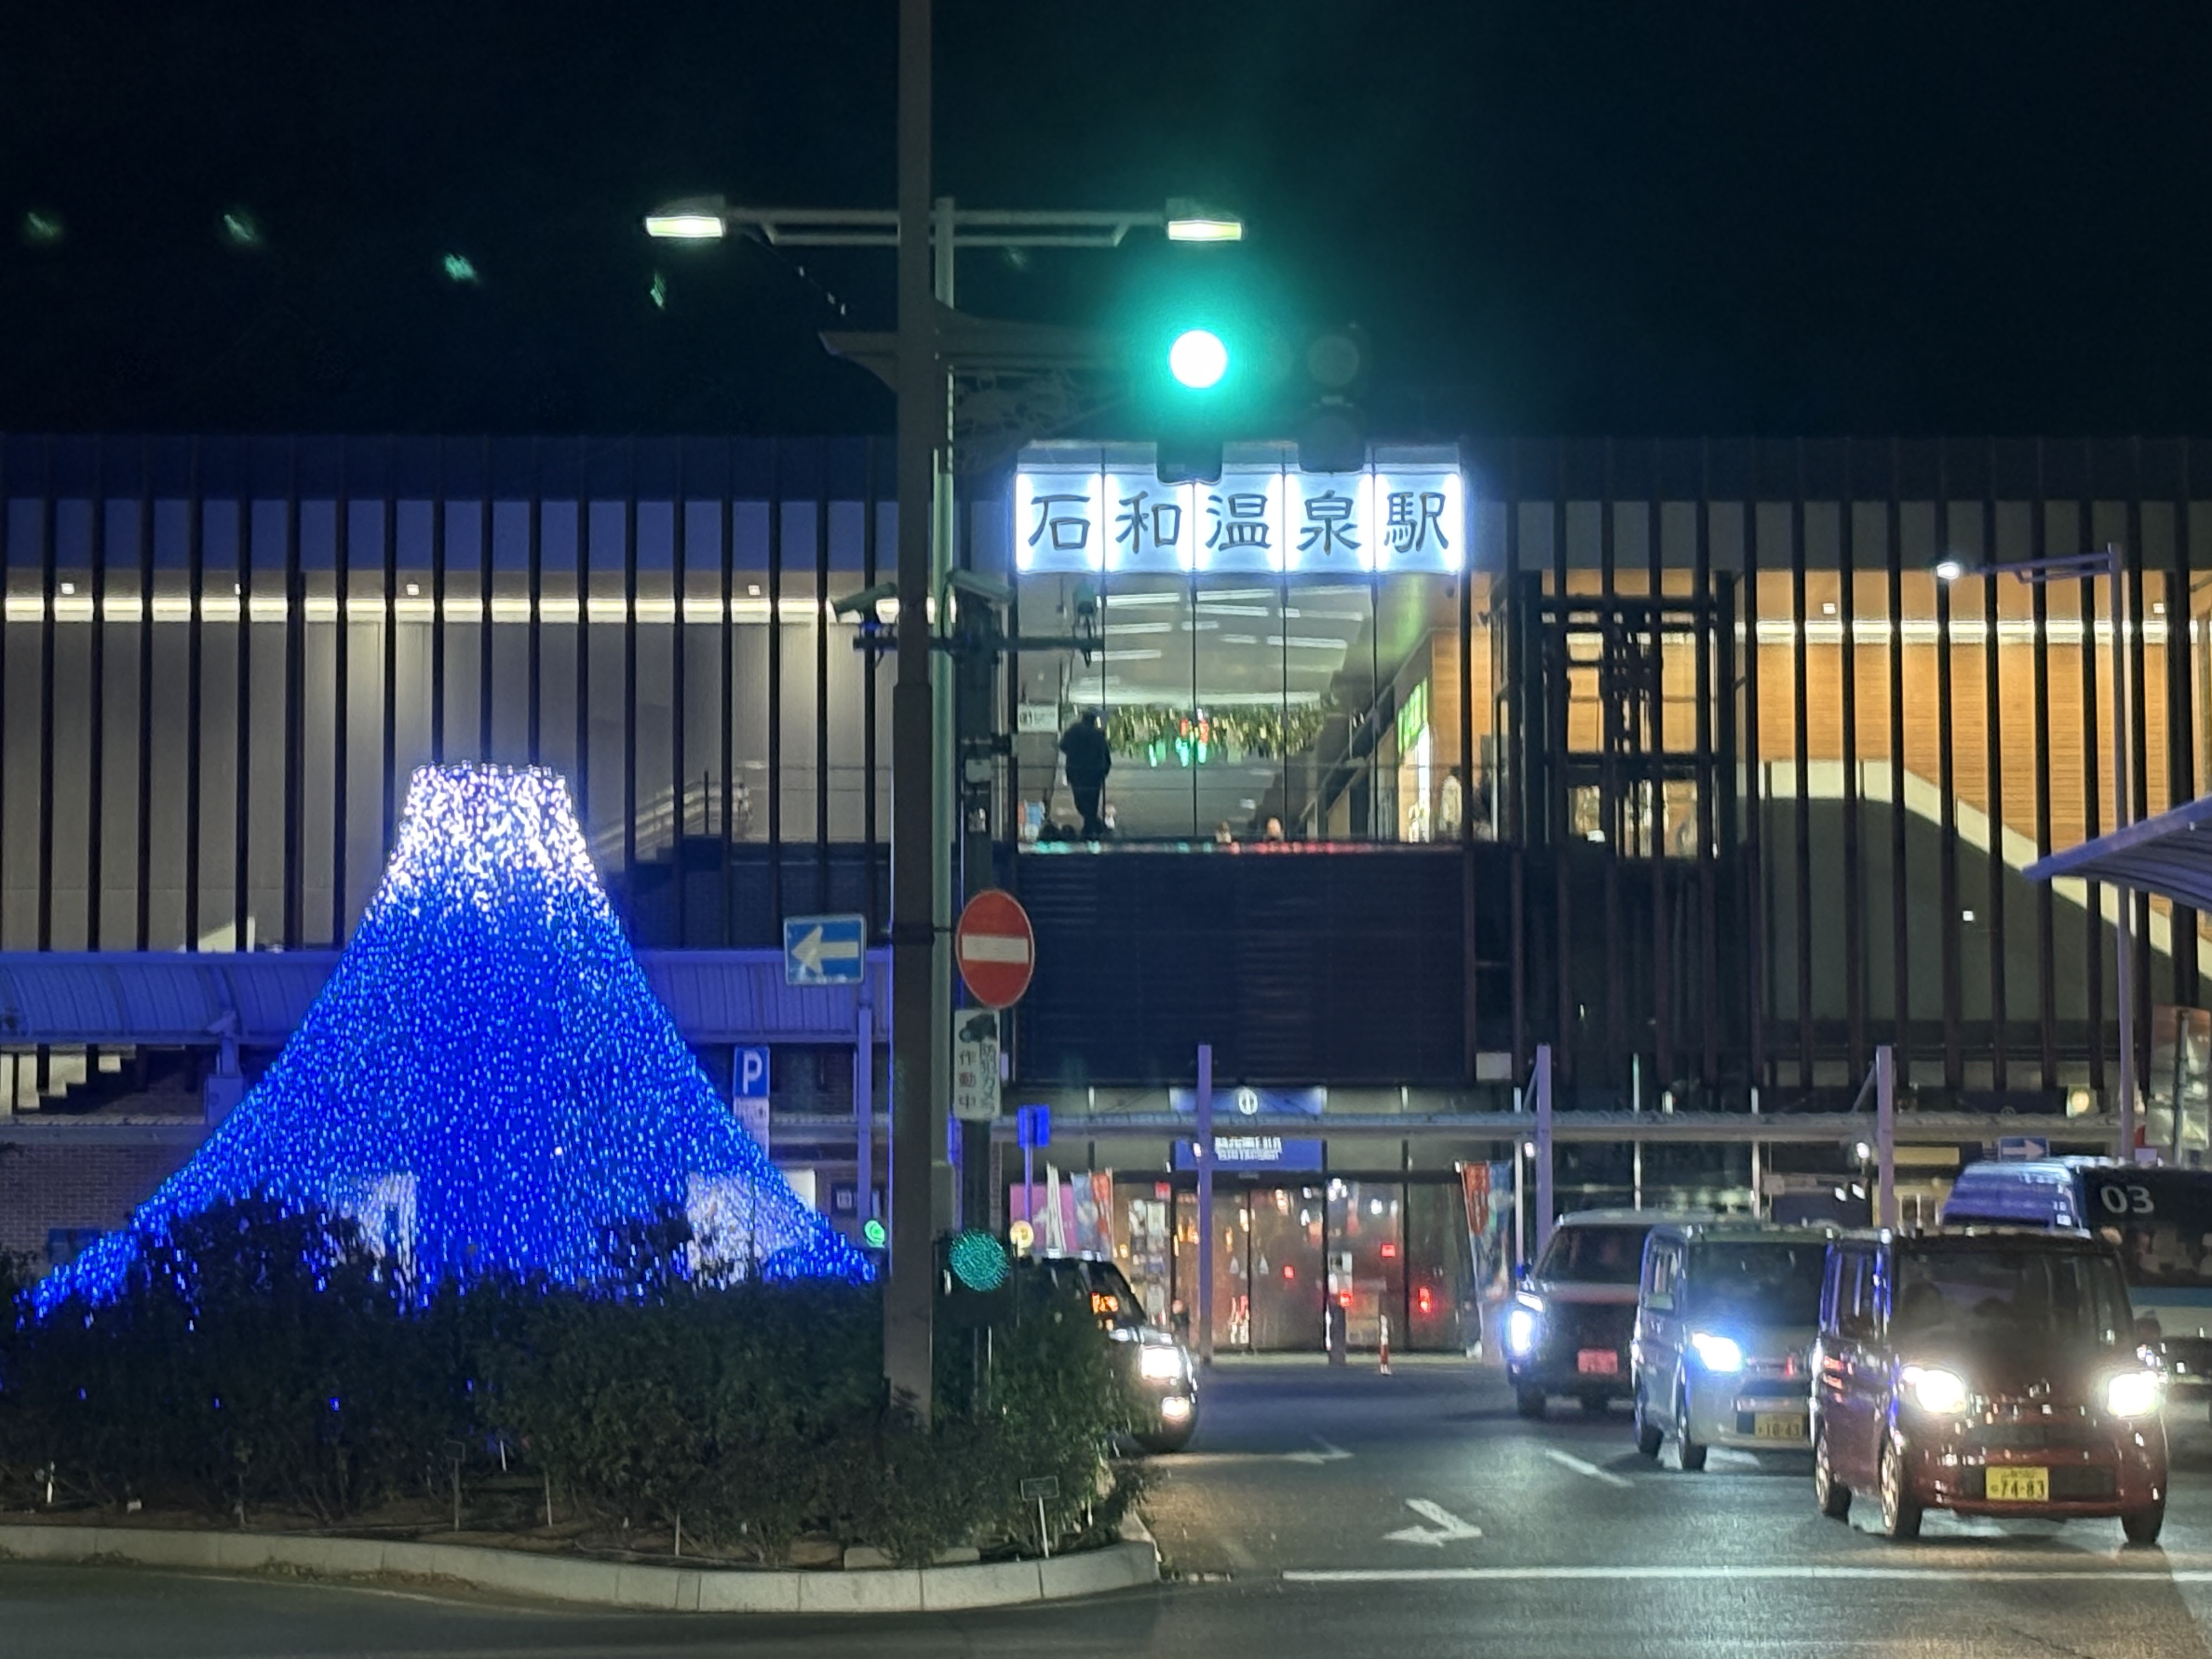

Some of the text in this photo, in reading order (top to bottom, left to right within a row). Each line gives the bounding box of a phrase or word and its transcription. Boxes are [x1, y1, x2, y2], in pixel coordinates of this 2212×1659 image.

[1028, 489, 1449, 555] 石和温泉駅
[742, 1050, 763, 1094] P
[2100, 1185, 2155, 1214] 03
